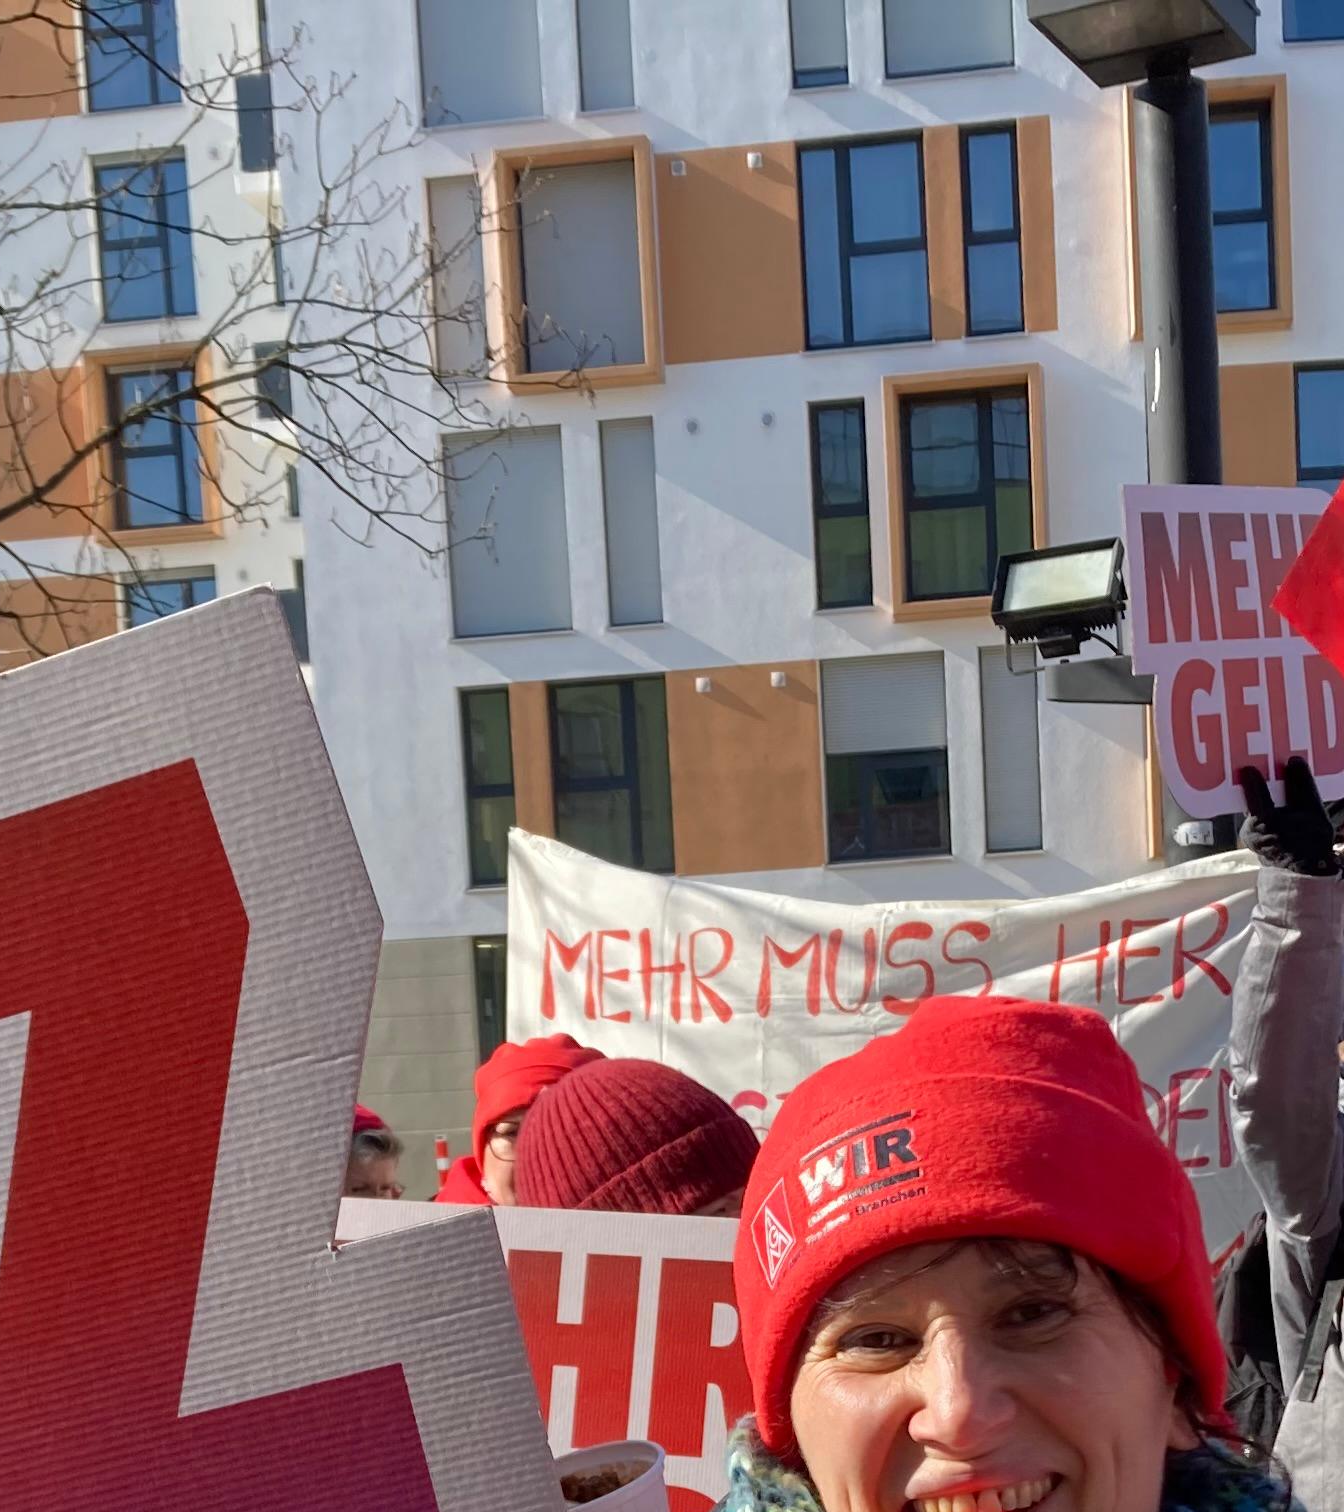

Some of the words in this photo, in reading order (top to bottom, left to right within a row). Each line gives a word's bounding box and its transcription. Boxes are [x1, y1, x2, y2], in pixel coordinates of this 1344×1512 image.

[1141, 512, 1322, 644] MEH
[540, 926, 734, 1025] MEHR
[757, 920, 993, 1018] MUSS
[1049, 902, 1233, 1006] HER
[798, 1128, 919, 1205] WIR
[855, 1186, 927, 1216] Branchen
